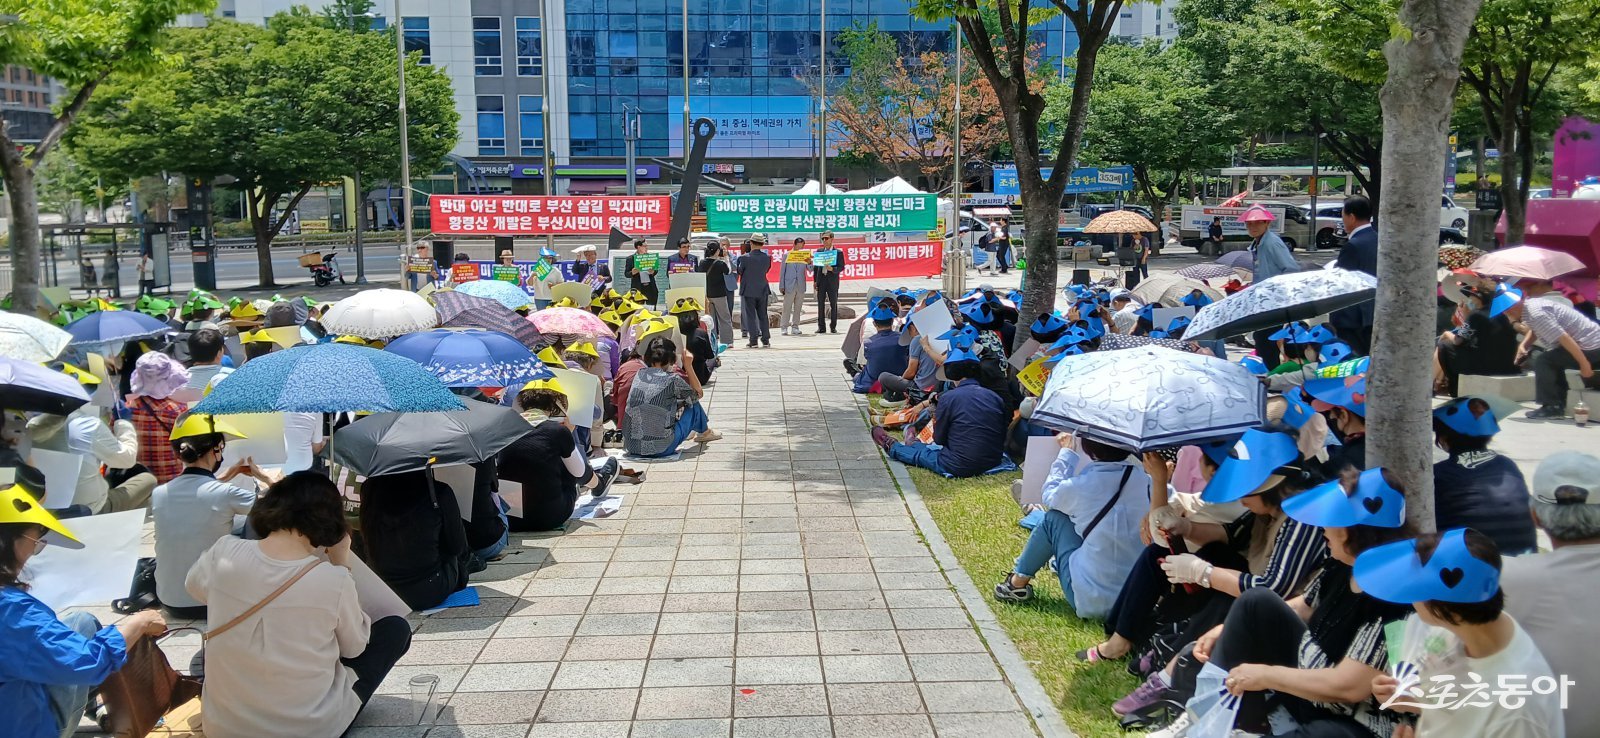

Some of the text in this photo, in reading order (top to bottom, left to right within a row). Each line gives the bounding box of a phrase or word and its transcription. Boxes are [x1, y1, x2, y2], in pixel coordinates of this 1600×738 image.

[732, 118, 750, 128] 중심,
[752, 118, 783, 128] 역세권의
[787, 118, 802, 128] 가치
[440, 199, 661, 213] 반대 아닌 반대로 부산 살길 막지마라
[716, 197, 926, 213] 500만명 관광시대 부산! 황령산 랜드마크
[449, 216, 652, 231] 황령산 개발은 부산시민이 원한다!
[742, 214, 901, 229] 조성으로 부산관광경제 살리자!
[847, 247, 881, 262] 황령산
[885, 244, 934, 260] 케이블카!
[839, 263, 875, 278] 하라!!
